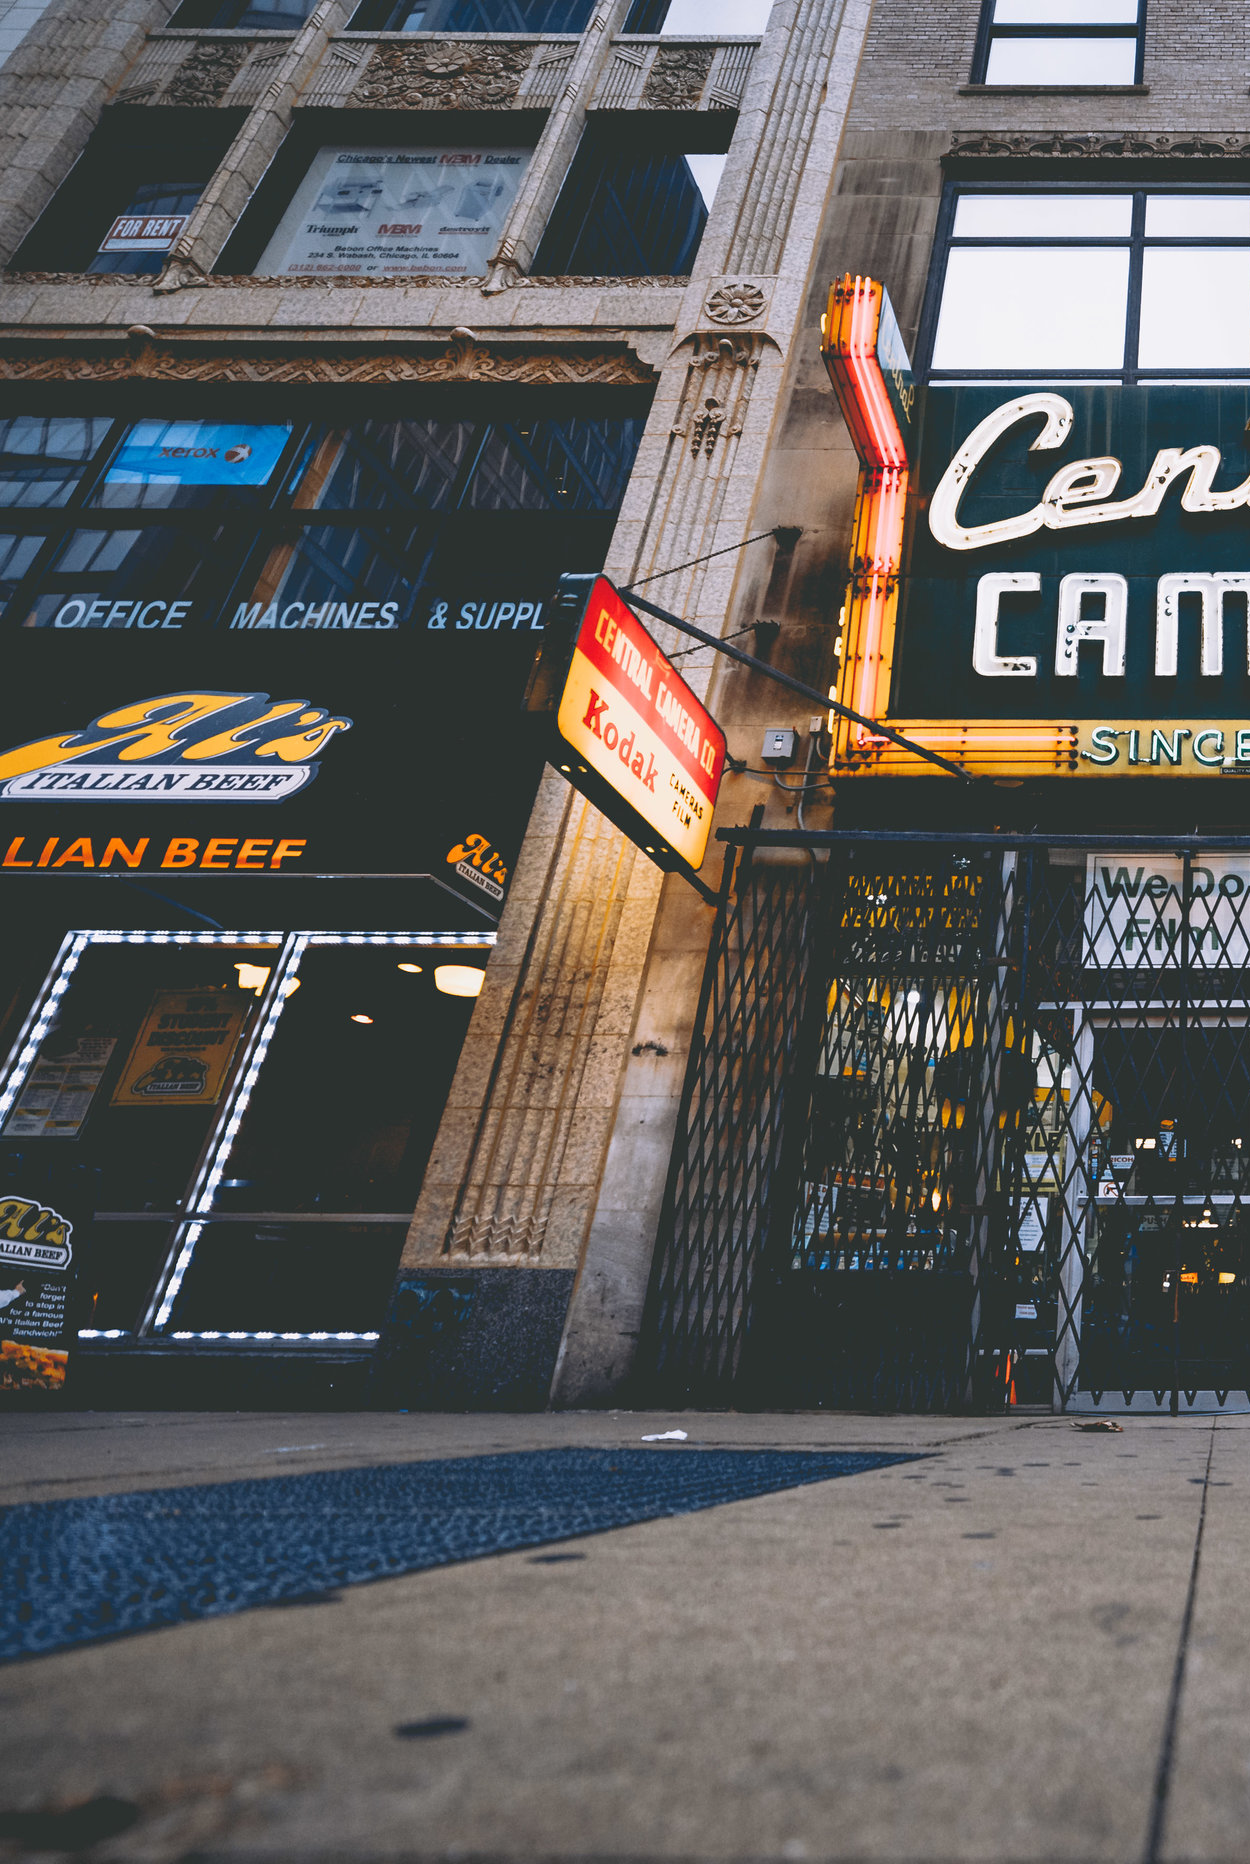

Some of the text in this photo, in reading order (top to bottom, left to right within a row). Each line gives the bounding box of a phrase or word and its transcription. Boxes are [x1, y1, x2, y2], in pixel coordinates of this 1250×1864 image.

[337, 153, 394, 164] Chicago's
[395, 154, 438, 164] Newest
[483, 155, 522, 164] Dealer
[112, 219, 182, 237] FOR RENT
[306, 224, 360, 235] Triumph
[376, 224, 423, 235] MBM
[338, 252, 376, 260] Wabash,
[379, 252, 419, 260] Chicago,
[158, 446, 220, 459] xerox
[54, 600, 192, 629] OFFICE
[229, 602, 399, 630] MACHINES
[427, 602, 449, 630] &
[594, 608, 716, 780] CENTRAL CAMERA CO.
[0, 693, 351, 781] Al's
[582, 687, 659, 794] Kodak
[21, 772, 293, 792] ITALIAN BEEF
[669, 773, 704, 820] CAMERAS
[672, 800, 692, 830] FILM
[2, 837, 307, 869] LIAN BEEF
[446, 833, 508, 885] Al's
[458, 863, 502, 897] ITALIAN BEEF
[1101, 866, 1245, 899] We Do
[1125, 918, 1219, 951] Film
[0, 1200, 67, 1246] Al's
[34, 1247, 63, 1260] BEEF
[25, 1300, 65, 1310] to stop in
[40, 1292, 66, 1302] forget
[15, 1318, 41, 1327] Italian
[42, 1320, 64, 1328] Beef
[32, 1309, 64, 1319] famous
